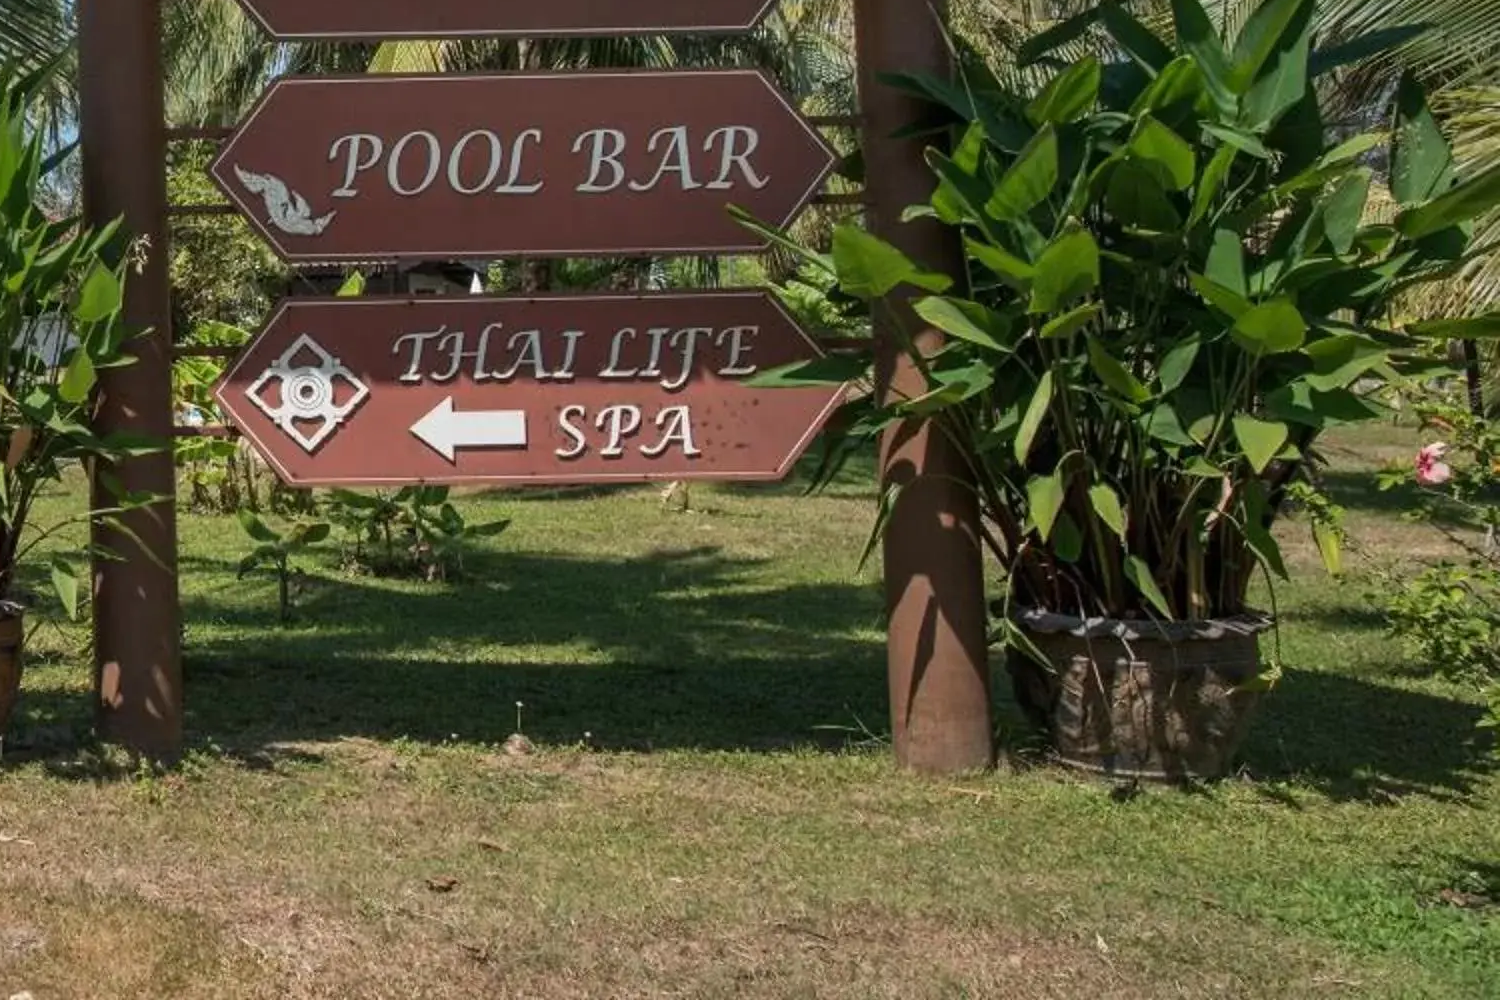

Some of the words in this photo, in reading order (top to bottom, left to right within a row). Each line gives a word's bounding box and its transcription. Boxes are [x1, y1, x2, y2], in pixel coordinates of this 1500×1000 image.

[328, 128, 544, 197] POOL
[571, 125, 771, 192] BAR
[392, 322, 585, 382] THAI
[597, 325, 760, 389] LIFE
[554, 404, 702, 457] SPA
